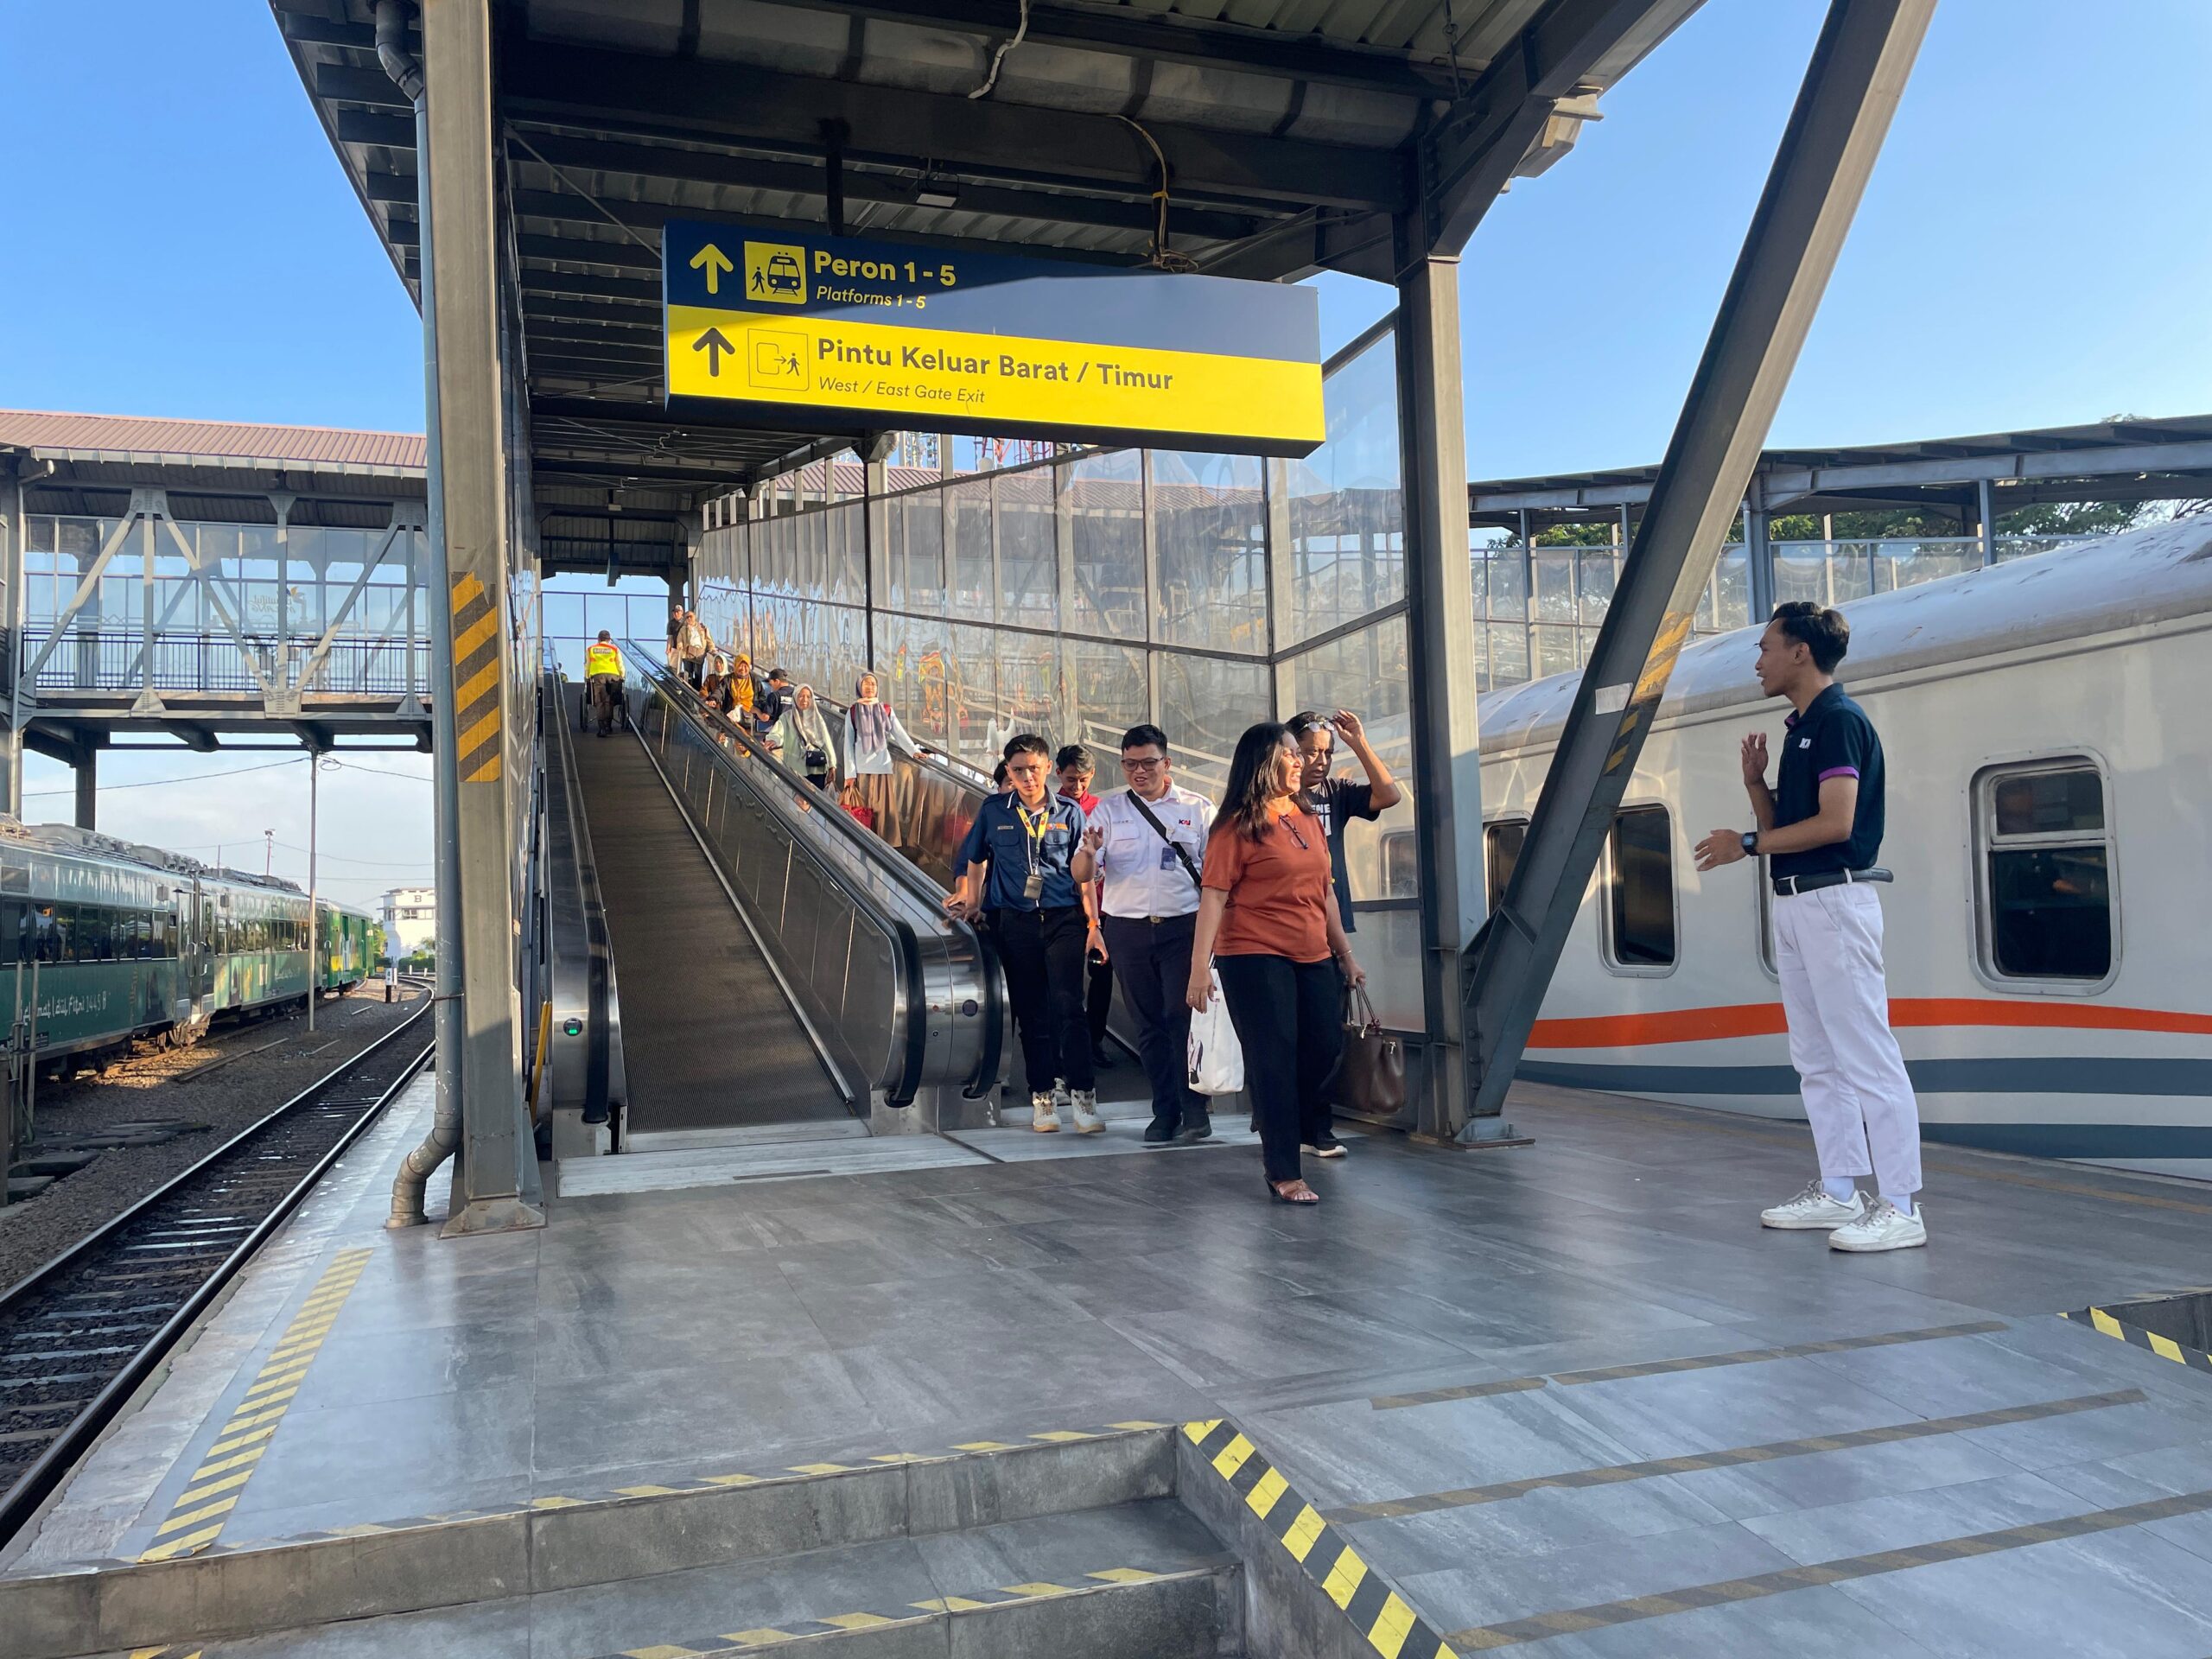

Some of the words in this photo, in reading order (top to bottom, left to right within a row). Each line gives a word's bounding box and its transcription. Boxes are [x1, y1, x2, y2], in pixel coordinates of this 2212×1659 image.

[814, 251, 897, 281] Peron
[904, 261, 916, 283] 1
[939, 264, 957, 287] 5
[817, 285, 892, 307] Platforms
[897, 294, 903, 308] 1
[916, 296, 926, 309] 5
[817, 338, 892, 366] Pintu
[902, 346, 990, 375] Keluar
[999, 354, 1069, 383] Barat
[1077, 361, 1089, 384] /
[1096, 363, 1173, 390] Timur
[819, 376, 858, 393] West
[862, 380, 873, 394] /
[876, 381, 911, 397] East
[914, 385, 952, 401] Gate
[957, 388, 986, 404] Exit
[414, 894, 423, 903] B
